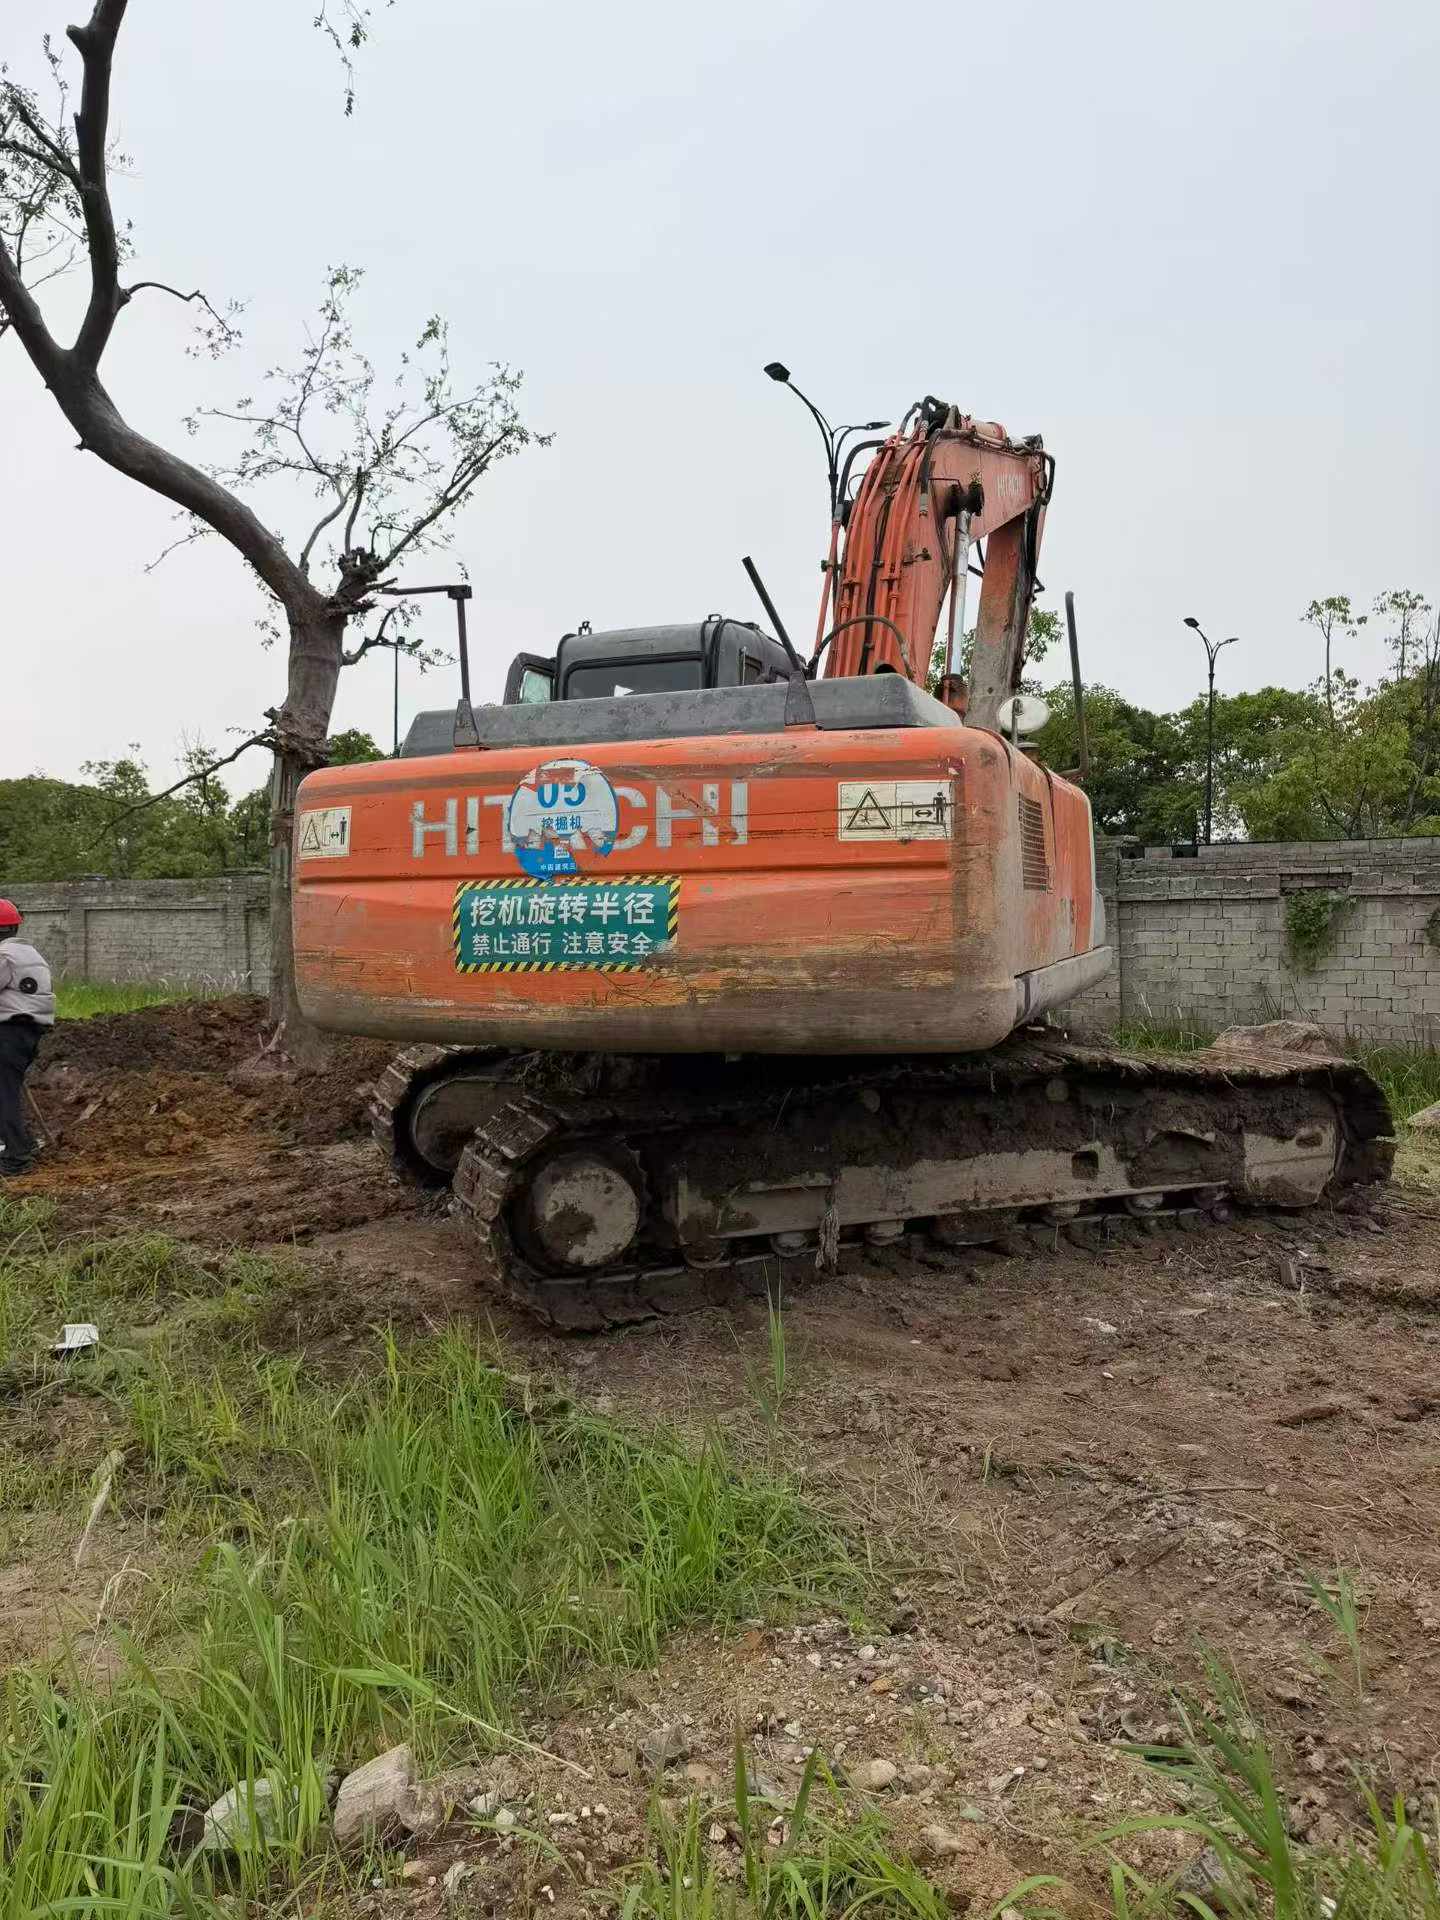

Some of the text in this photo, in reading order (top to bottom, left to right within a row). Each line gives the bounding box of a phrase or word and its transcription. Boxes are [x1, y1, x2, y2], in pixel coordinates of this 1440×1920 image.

[409, 782, 749, 857] HITCHI
[470, 891, 655, 928] 挖机旋转半径
[471, 930, 654, 957] 禁止通行 注意安全
